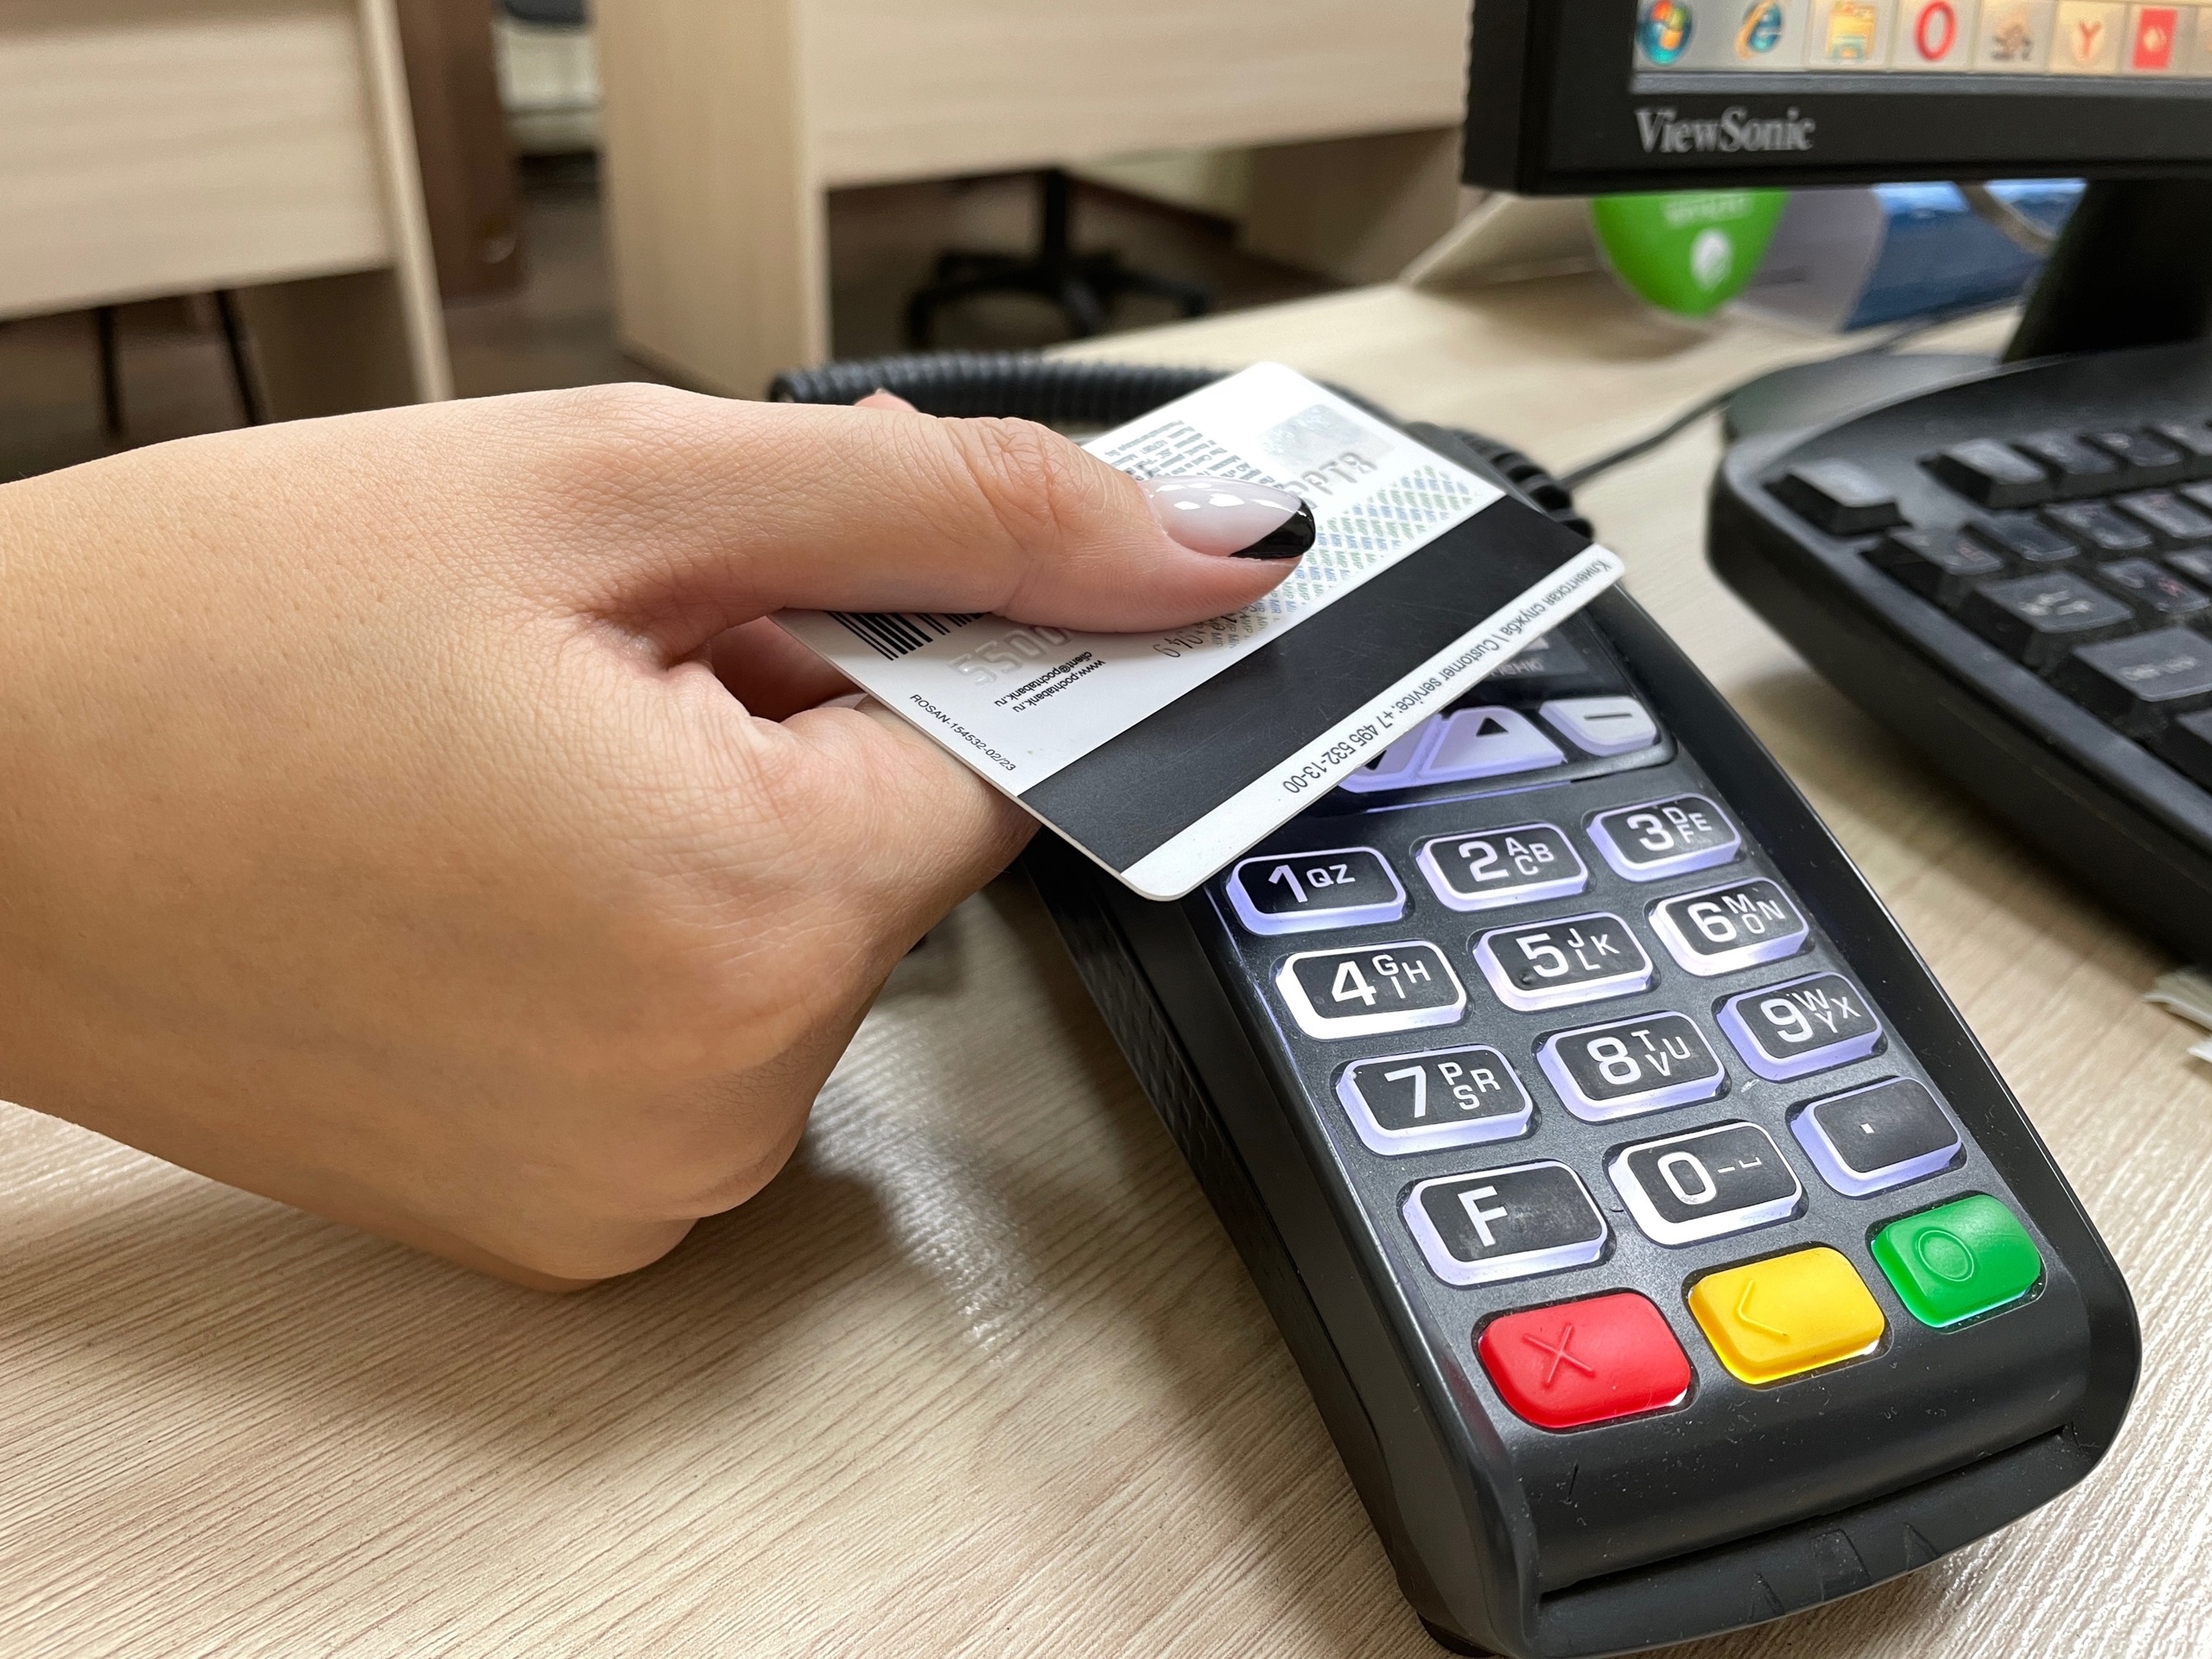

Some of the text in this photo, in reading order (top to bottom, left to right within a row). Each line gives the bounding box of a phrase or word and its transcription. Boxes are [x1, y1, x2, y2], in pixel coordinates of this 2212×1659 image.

[1635, 105, 1816, 153] ViewSonic
[1500, 603, 1546, 634] служба
[994, 651, 1093, 707] client@pochtabank.ru
[1439, 639, 1500, 681] Customer
[1012, 659, 1107, 713] www.pochtabank.ru
[1392, 678, 1442, 714] service:
[910, 693, 1017, 772] ROSAN-154532-02/23
[1349, 723, 1379, 747] 495
[1376, 711, 1395, 728] +7
[1282, 741, 1357, 793] 532-13-00
[1628, 814, 1670, 852] 3
[1268, 865, 1308, 903] 1
[1459, 841, 1509, 883] 2
[1698, 897, 1735, 943] 6
[1516, 933, 1569, 979] 5
[1331, 961, 1377, 1006] 4
[1762, 998, 1808, 1044] 9
[1592, 1037, 1642, 1084] 8
[1383, 1068, 1427, 1118] 7
[1656, 1152, 1717, 1205] 0
[1458, 1186, 1506, 1246] F
